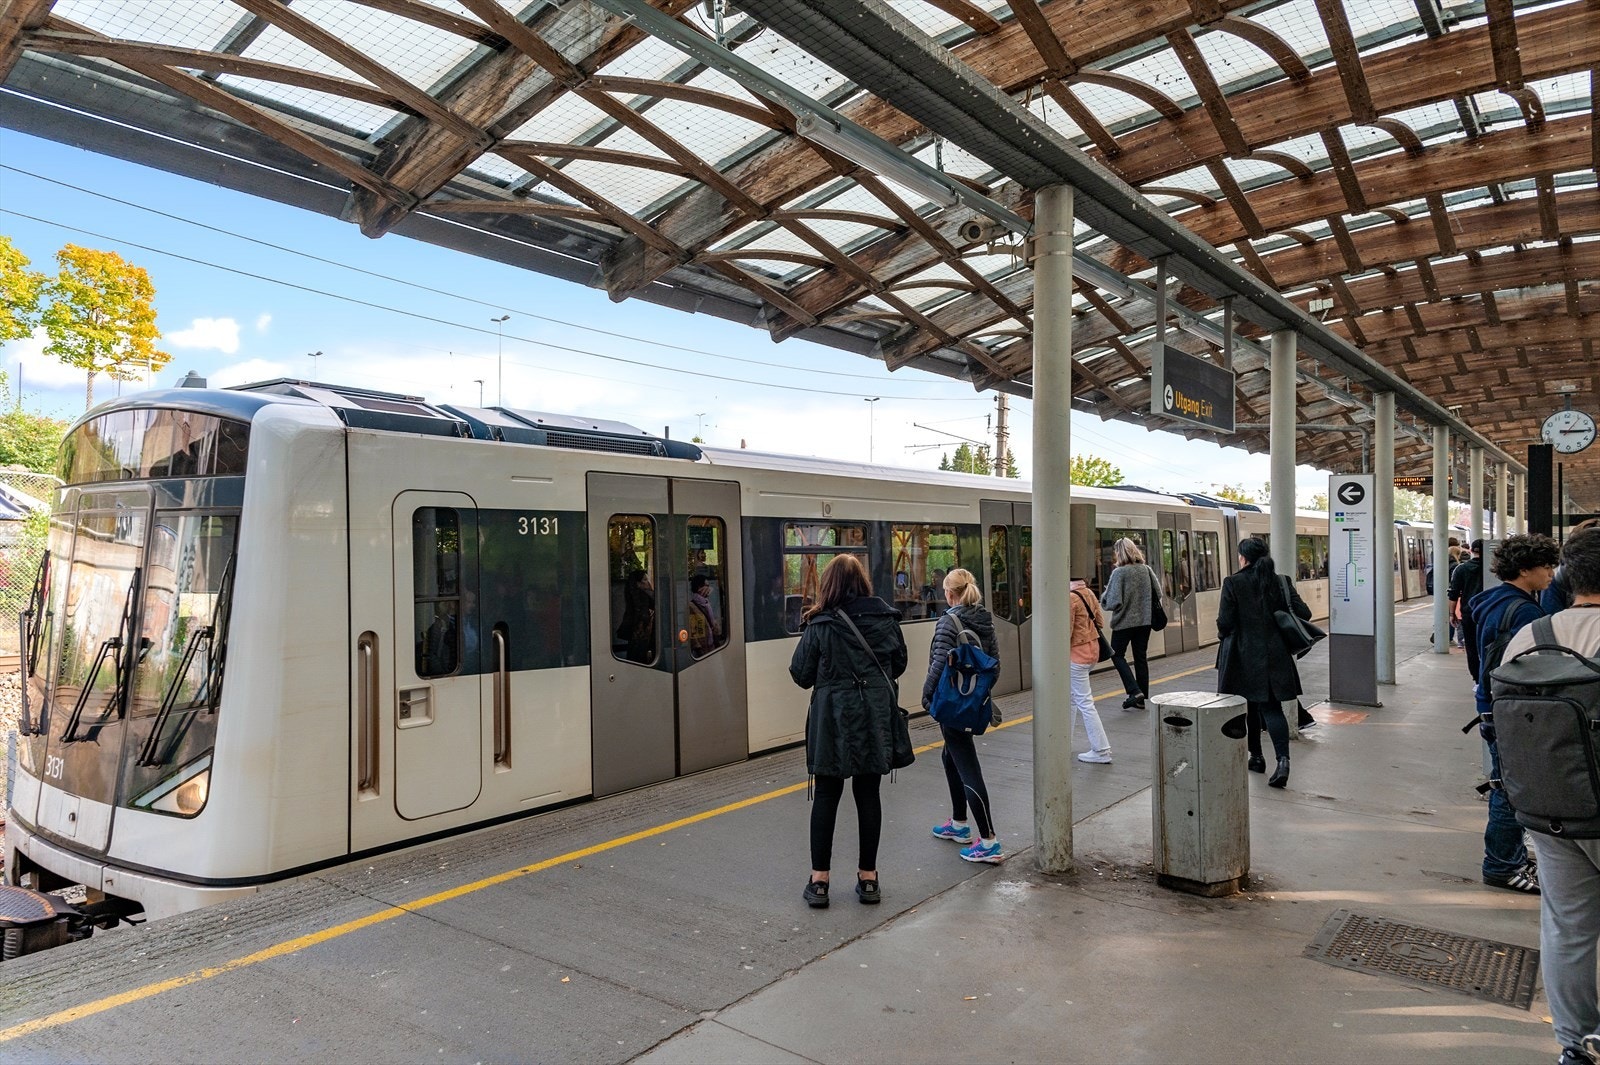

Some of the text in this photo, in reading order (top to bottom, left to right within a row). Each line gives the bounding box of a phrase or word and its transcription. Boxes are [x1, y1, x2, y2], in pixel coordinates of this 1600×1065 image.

[1175, 390, 1213, 418] Utgang Exit
[518, 516, 559, 535] 3131
[45, 754, 65, 780] 3131
